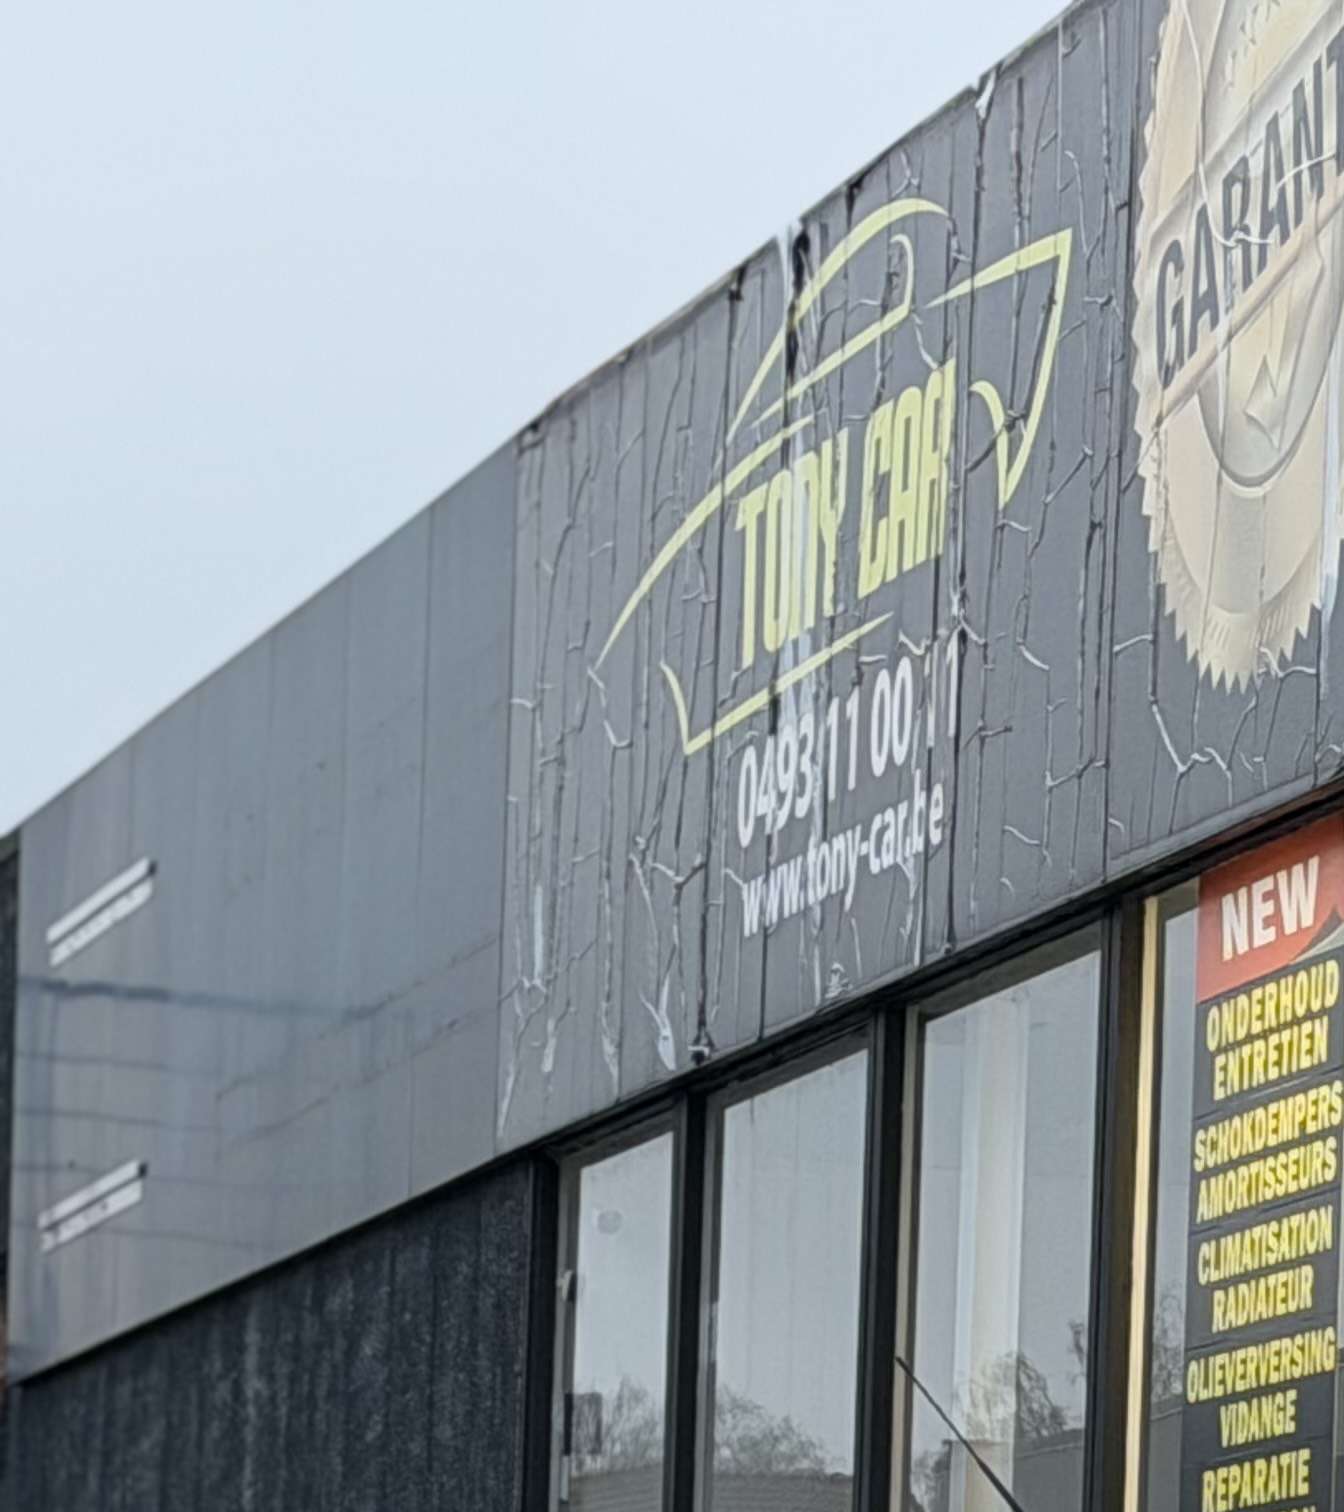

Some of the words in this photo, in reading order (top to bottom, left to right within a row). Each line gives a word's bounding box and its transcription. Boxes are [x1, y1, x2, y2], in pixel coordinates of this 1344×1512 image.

[735, 426, 849, 669] TONY
[857, 356, 957, 600] CAR
[1221, 855, 1320, 962] NEW
[1206, 959, 1340, 1053] ONDERHOUD
[1213, 1015, 1329, 1101] ENTRETIEN
[1193, 1080, 1344, 1172] SCHOKDEMPERS
[1196, 1136, 1338, 1224] AMORTISSEURS
[1198, 1205, 1333, 1286] CLIMATISATION
[1212, 1264, 1314, 1334] RADIATEUR
[1187, 1326, 1336, 1404] OLIEVERVERSING
[1220, 1389, 1298, 1448] VIDANGE
